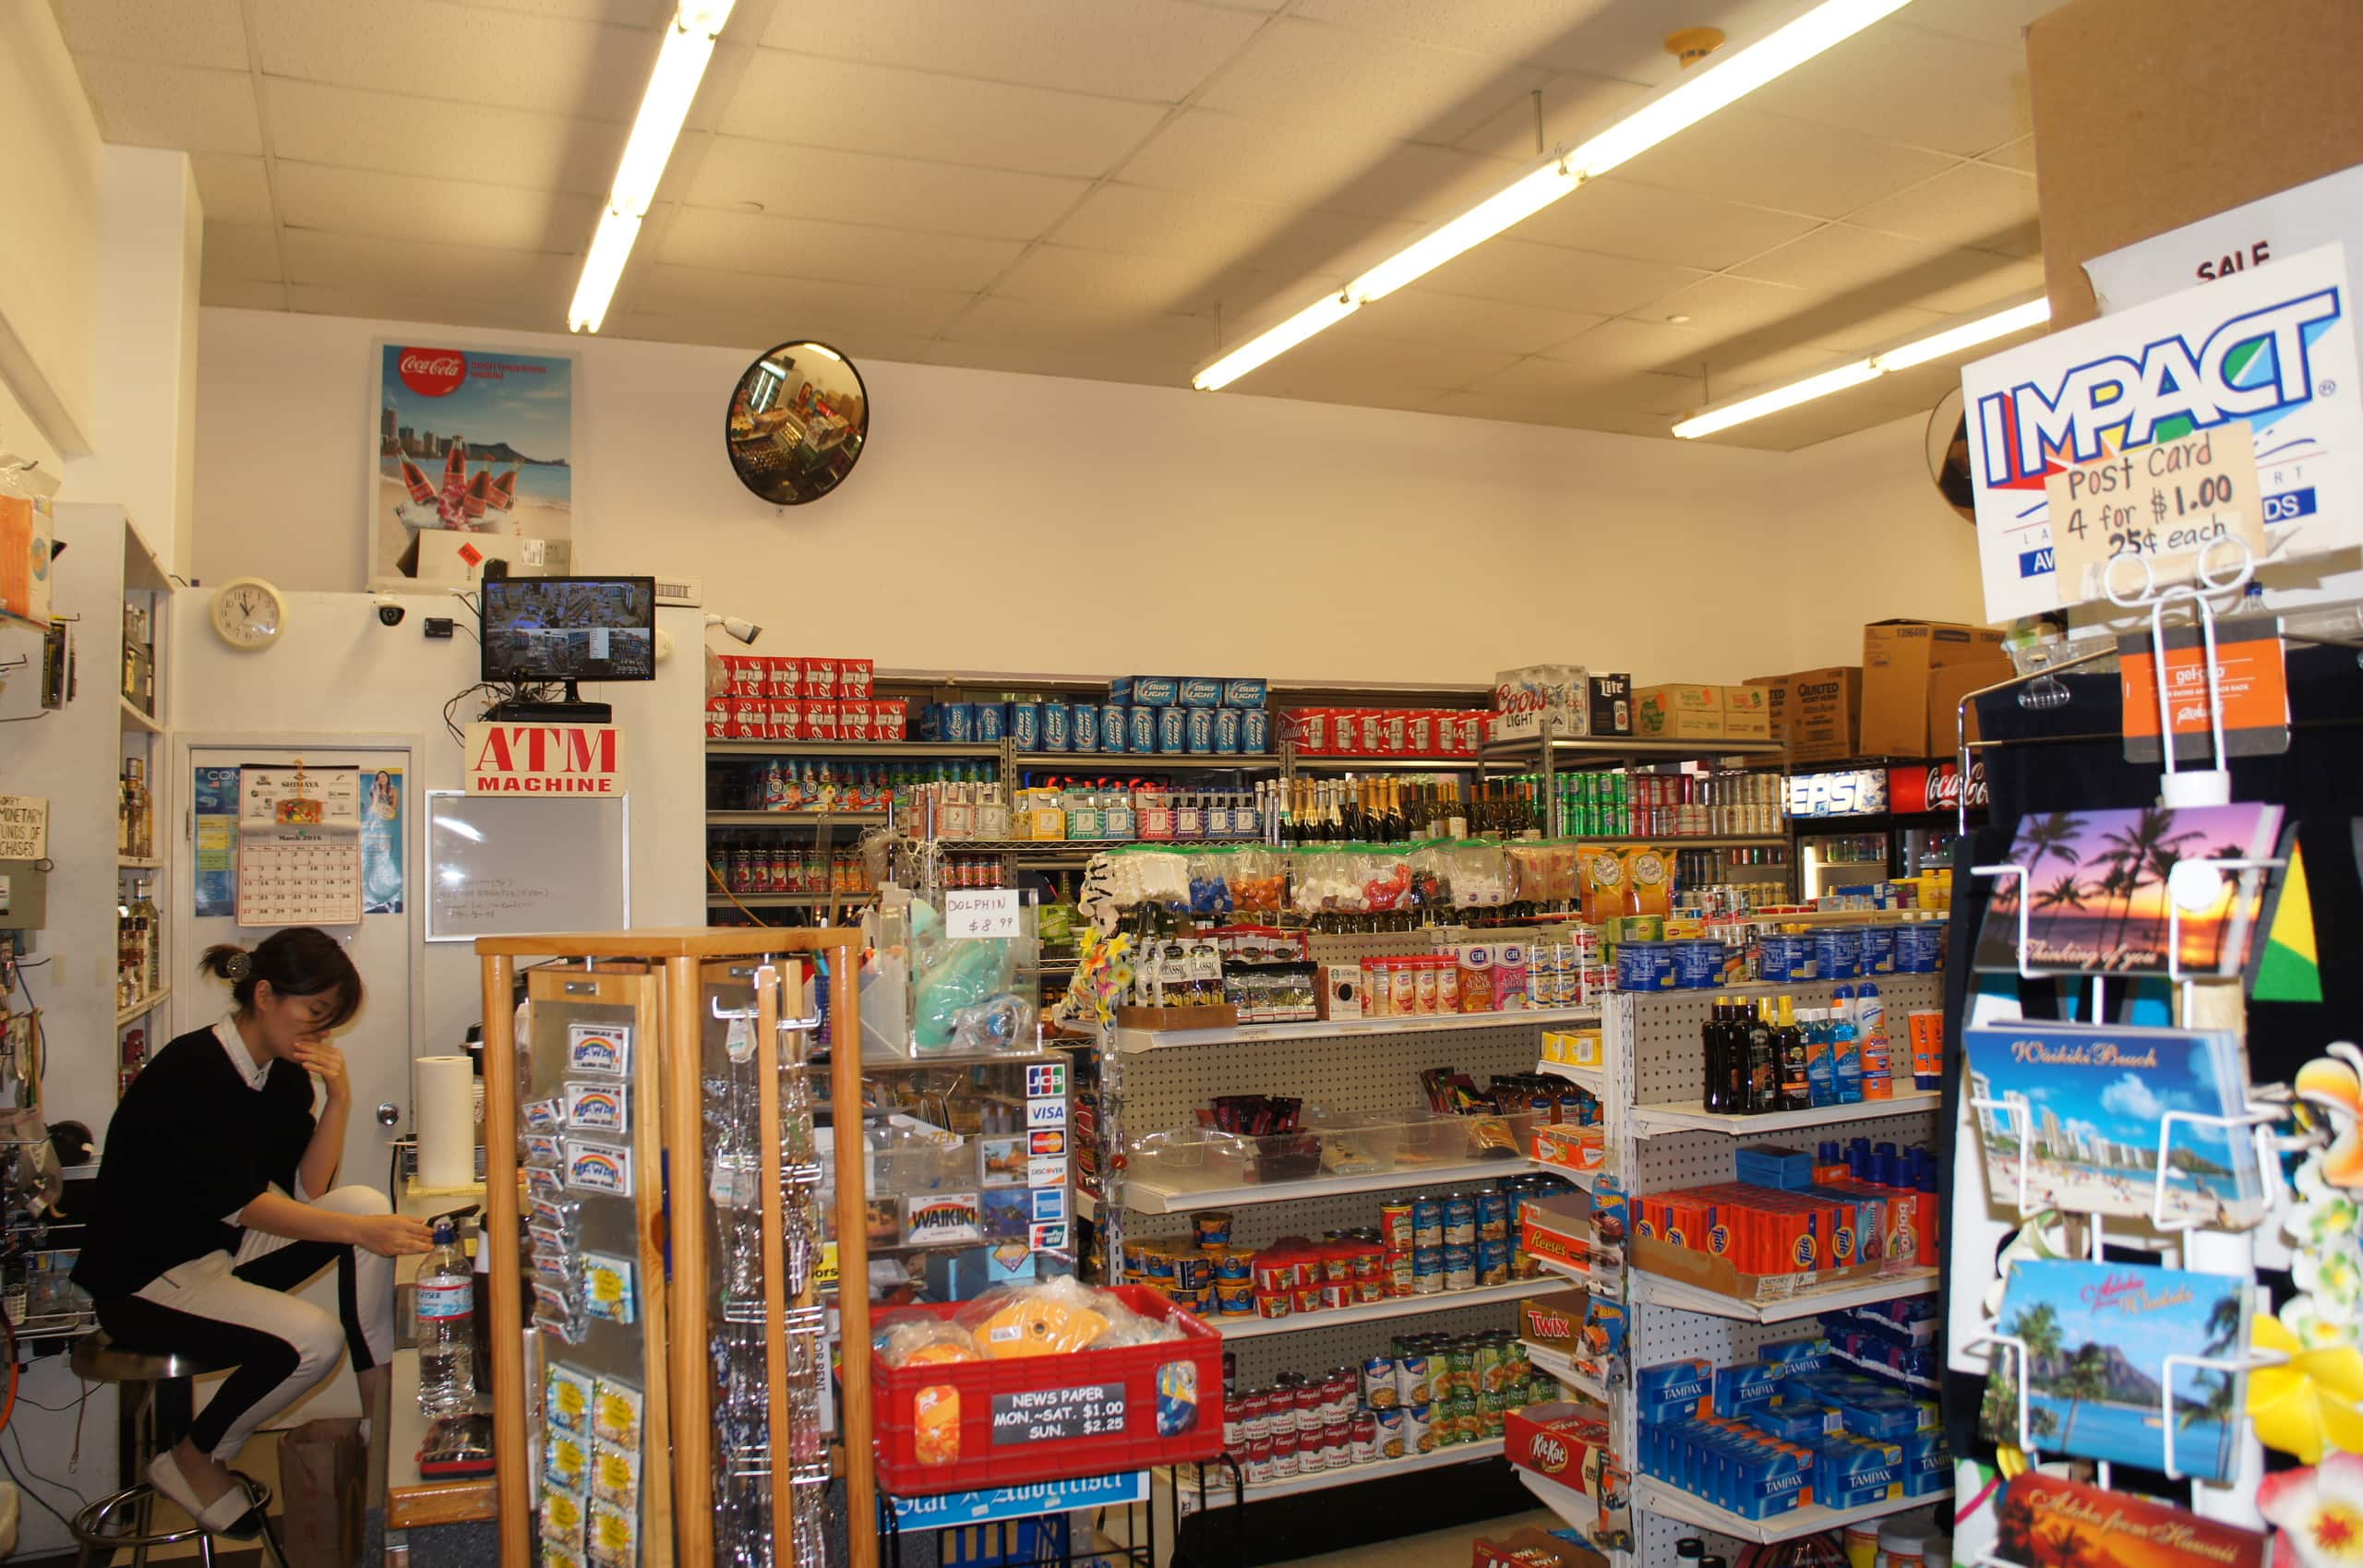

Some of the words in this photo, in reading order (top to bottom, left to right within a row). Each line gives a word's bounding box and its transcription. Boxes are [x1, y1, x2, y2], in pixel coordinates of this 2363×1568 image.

[1977, 286, 2342, 489] IMPACT
[2148, 431, 2213, 477] Card
[2067, 508, 2089, 541] 4
[2099, 503, 2137, 532] for
[2151, 473, 2233, 525] $1.00
[2167, 512, 2228, 550] each
[1495, 683, 1548, 717] Coors
[1505, 712, 1535, 729] LIGHT
[471, 726, 620, 773] ATM
[477, 776, 612, 793] MACHINE
[1781, 772, 1865, 815] EPSI
[0, 841, 36, 857] CHASES
[948, 896, 1006, 912] DOLPHIN
[969, 917, 1013, 933] $8.99
[2101, 942, 2126, 970] of
[2120, 951, 2158, 970] you
[2010, 1040, 2092, 1064] Waikiki
[2092, 1042, 2158, 1068] Beach
[1029, 1074, 1063, 1087] JCB
[1033, 1107, 1064, 1119] VISA
[912, 1206, 977, 1229] WAIKIKI
[1713, 1227, 1728, 1252] Tide
[1799, 1237, 1813, 1264] Tide
[1837, 1229, 1851, 1256] Tide
[1783, 1358, 1822, 1375] TAMPAX
[1012, 1391, 1058, 1408] NEWS
[1062, 1386, 1104, 1403] PAPER
[1662, 1382, 1702, 1401] TAMPAX
[1740, 1382, 1775, 1400] TAMPAX
[1083, 1401, 1124, 1418] $1.00
[1028, 1424, 1065, 1440] SUN.
[1084, 1417, 1123, 1435] $2.25
[1765, 1475, 1803, 1493] TAMPAX
[1849, 1470, 1891, 1489] TAMPAX
[2029, 1489, 2103, 1525] Aloha
[2100, 1508, 2149, 1538] from
